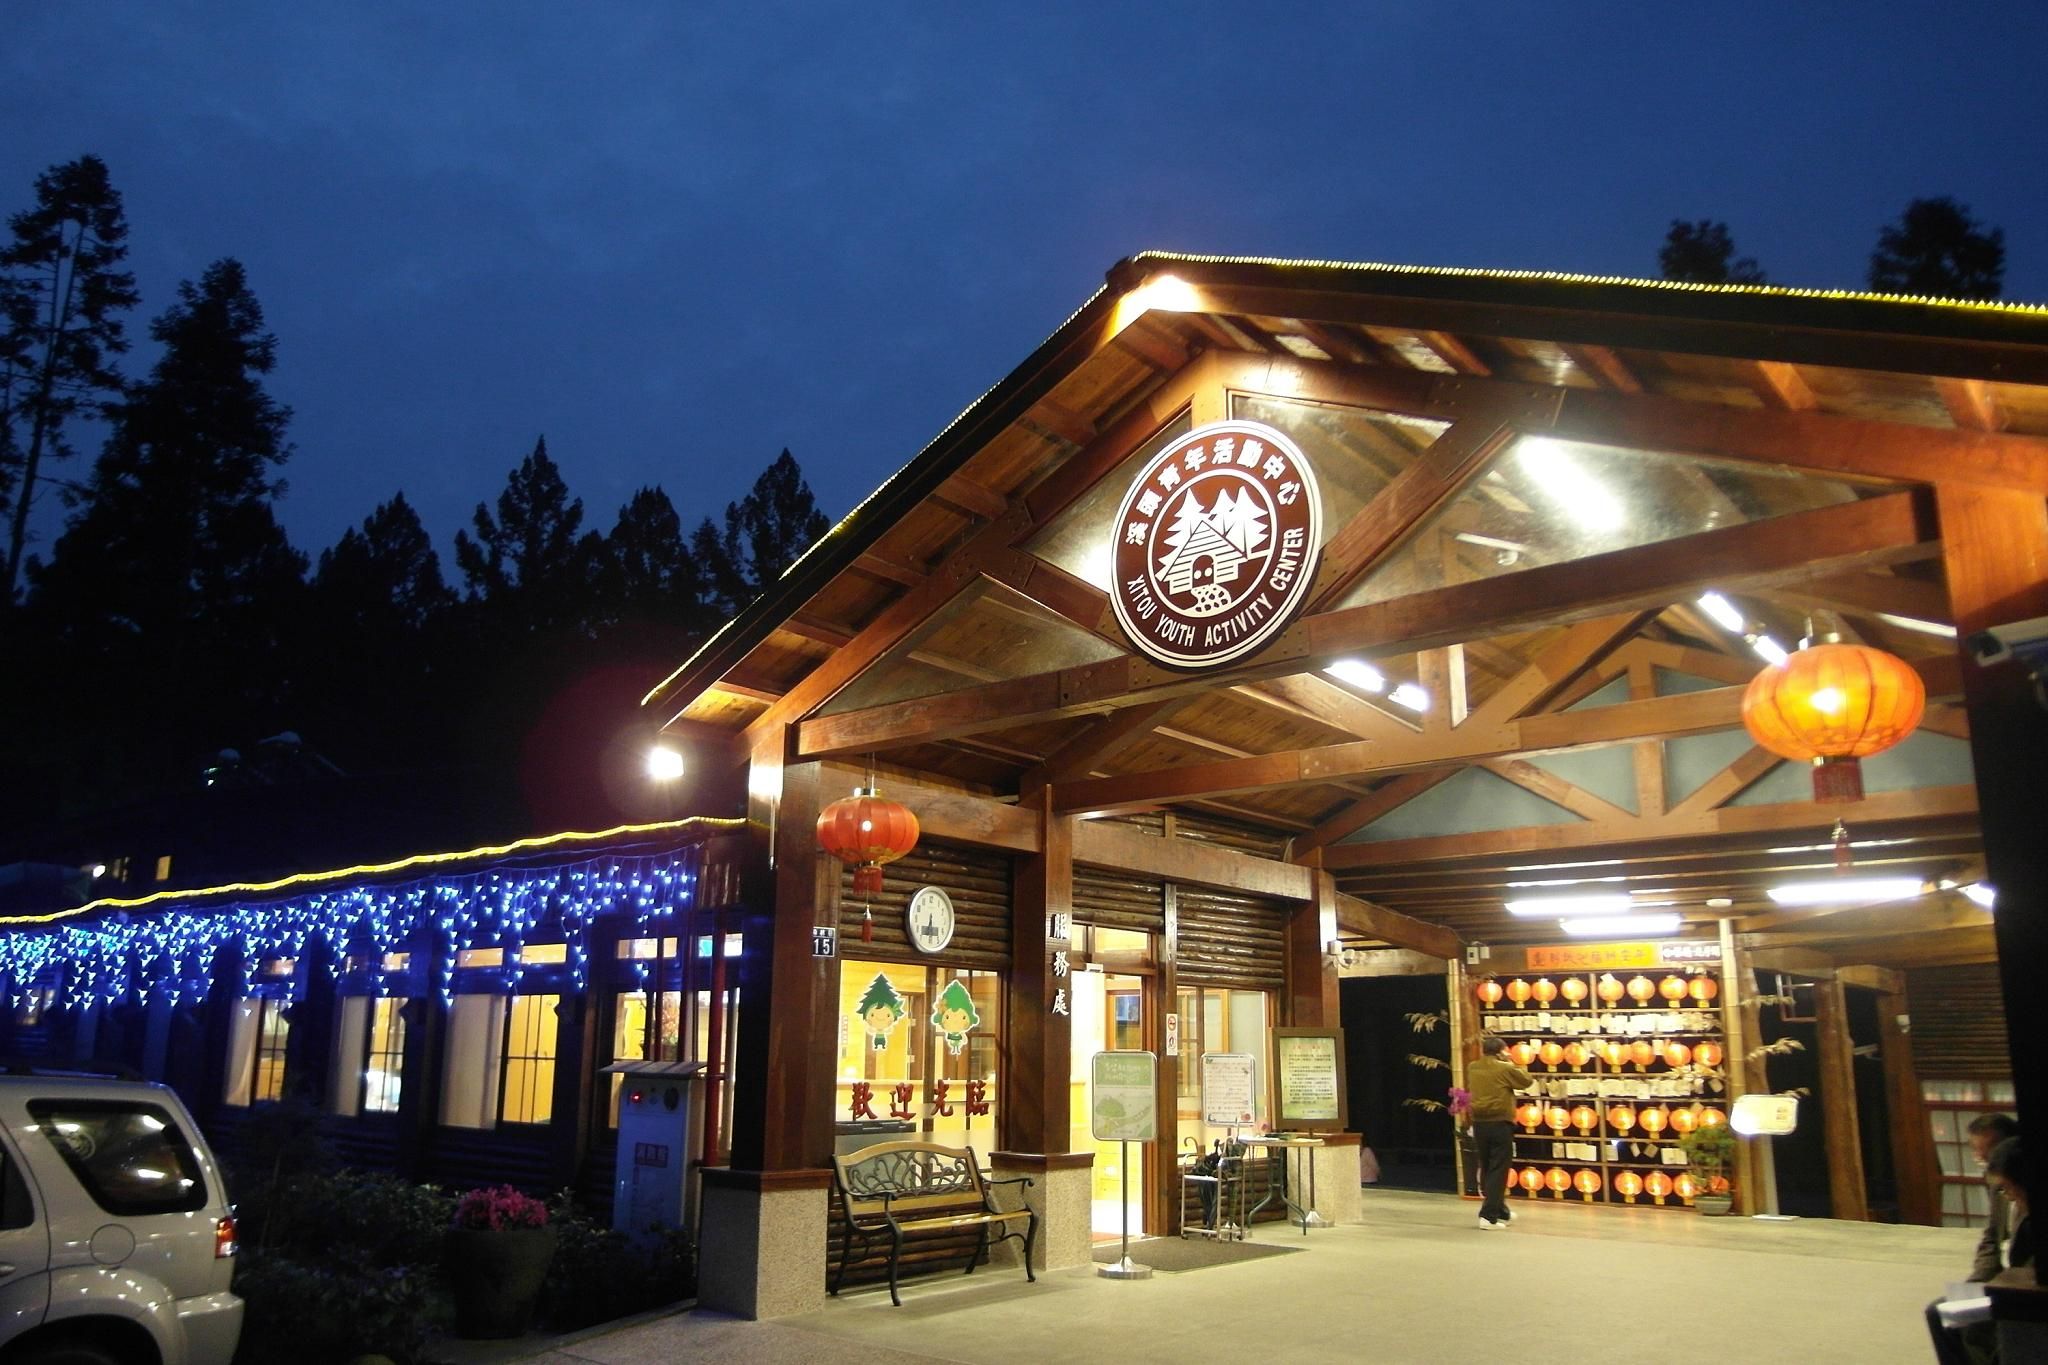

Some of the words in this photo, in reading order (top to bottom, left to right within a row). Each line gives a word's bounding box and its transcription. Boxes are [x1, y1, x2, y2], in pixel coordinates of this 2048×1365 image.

[1127, 574, 1158, 620] XITOU
[1155, 613, 1196, 647] YOUTH
[1204, 592, 1273, 647] ACTIVITY
[1269, 527, 1304, 591] CENTER
[813, 938, 830, 955] 15
[1052, 912, 1070, 1016] 服務處
[848, 1079, 990, 1121] 歡迎光臨
